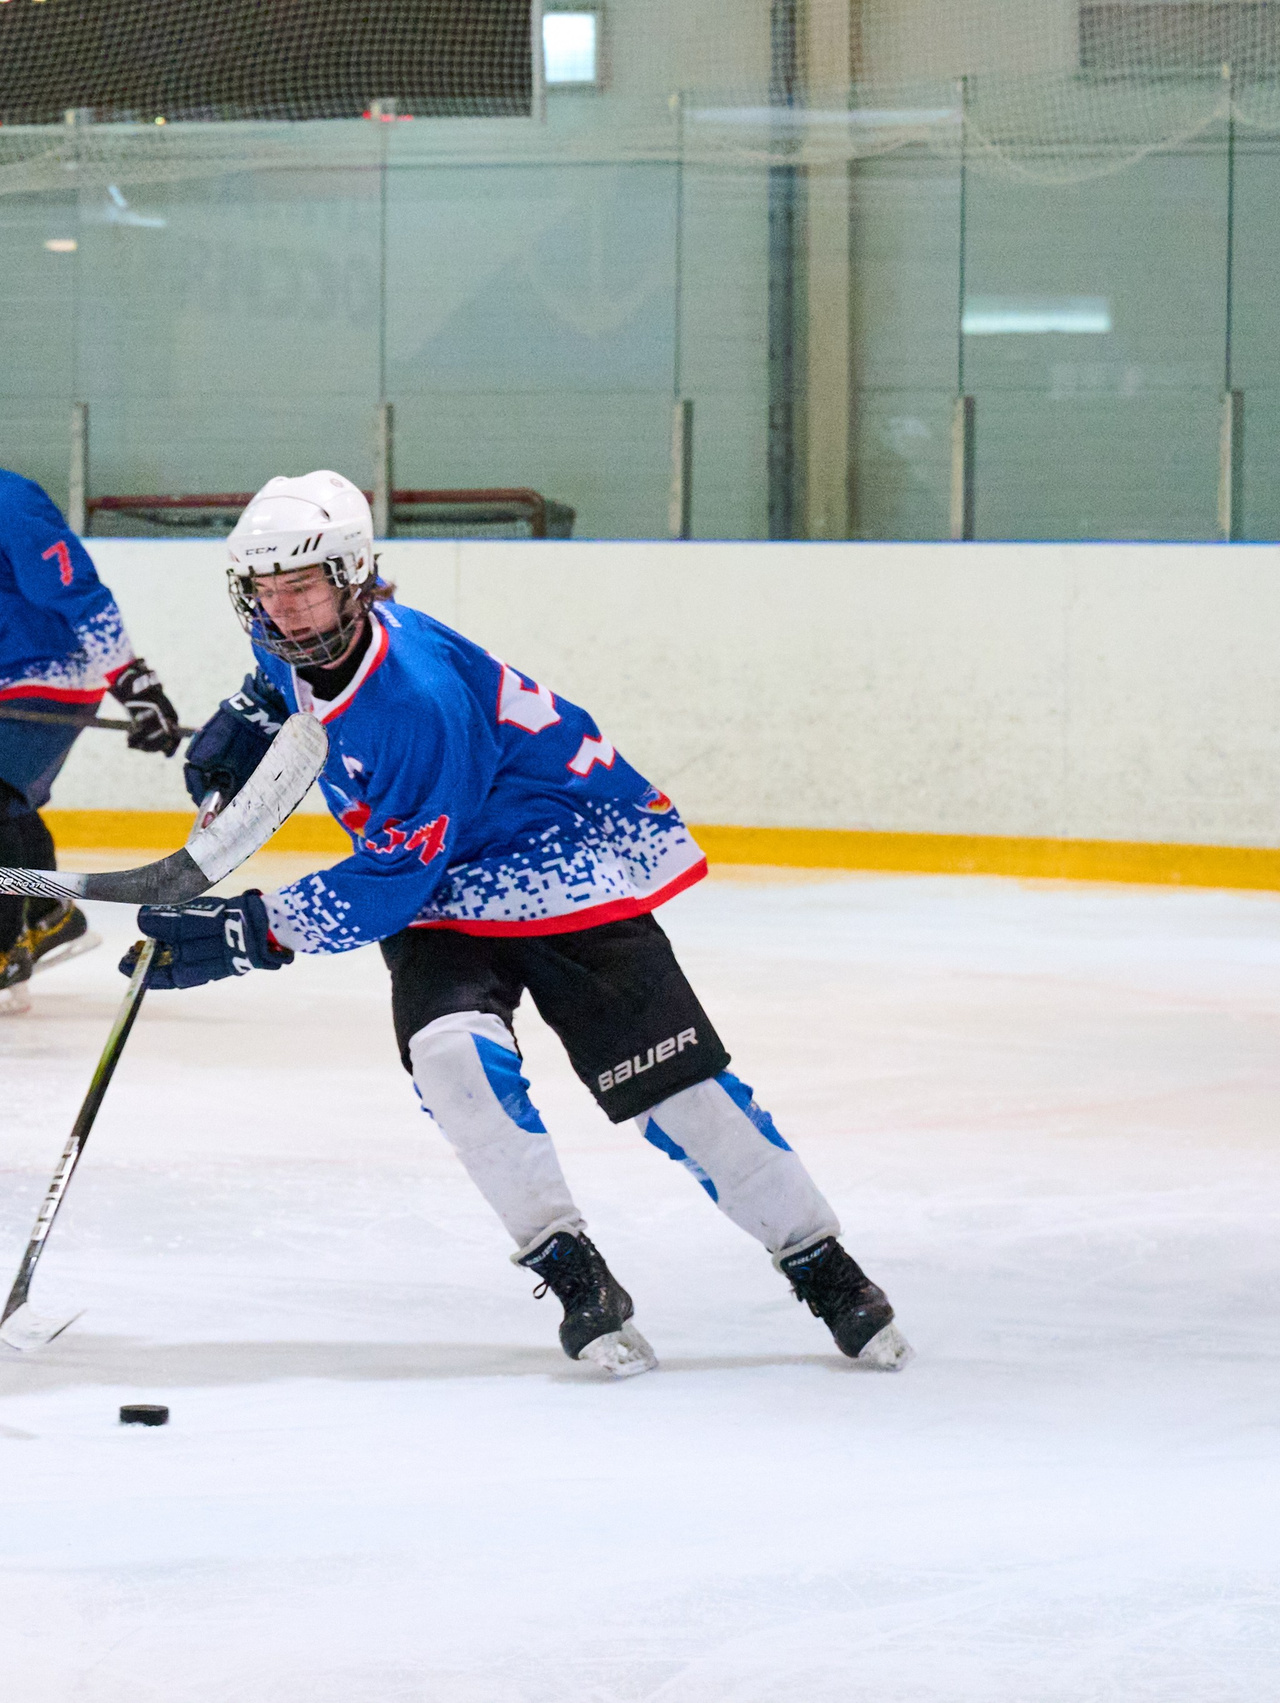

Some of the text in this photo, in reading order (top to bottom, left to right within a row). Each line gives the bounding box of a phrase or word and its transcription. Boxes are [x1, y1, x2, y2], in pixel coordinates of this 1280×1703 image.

[41, 540, 74, 586] 7
[245, 546, 277, 556] CCM
[228, 691, 283, 735] CM
